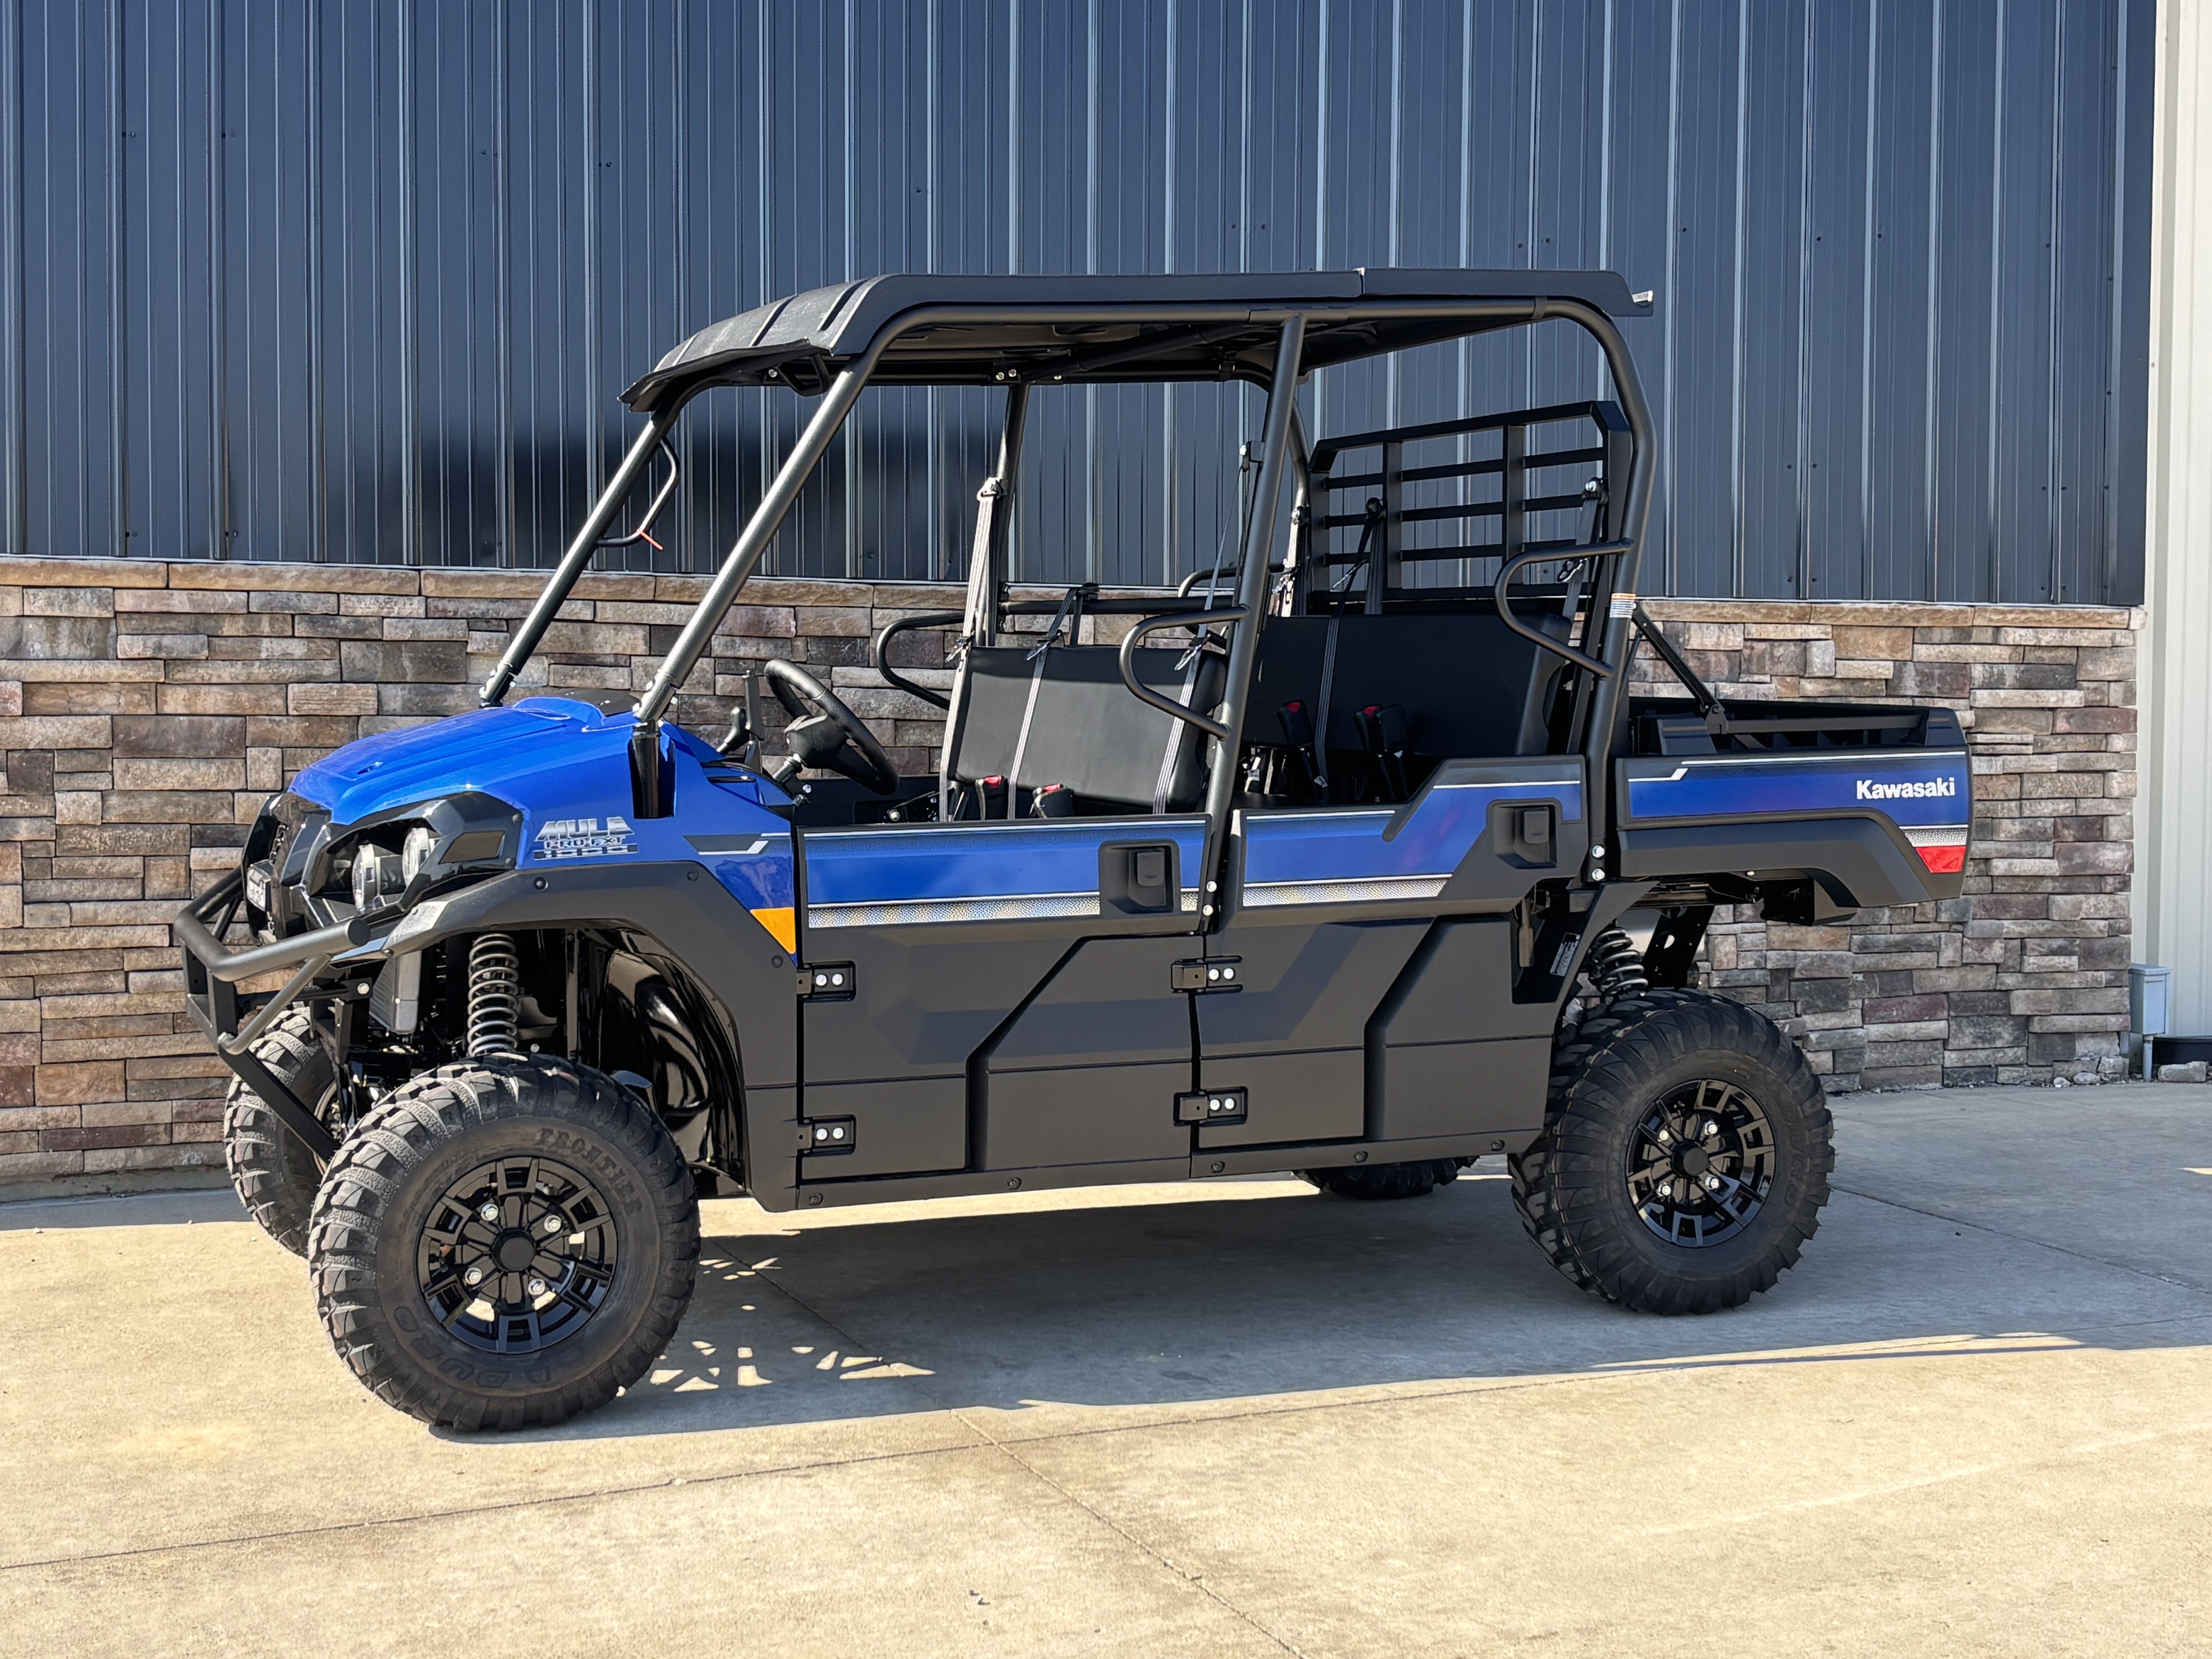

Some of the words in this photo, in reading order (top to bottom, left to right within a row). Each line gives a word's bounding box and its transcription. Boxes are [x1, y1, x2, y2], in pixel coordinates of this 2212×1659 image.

[1856, 777, 1955, 799] Kawasaki
[534, 816, 635, 842] MULE
[543, 846, 628, 858] 1000
[393, 1305, 511, 1389] DURO
